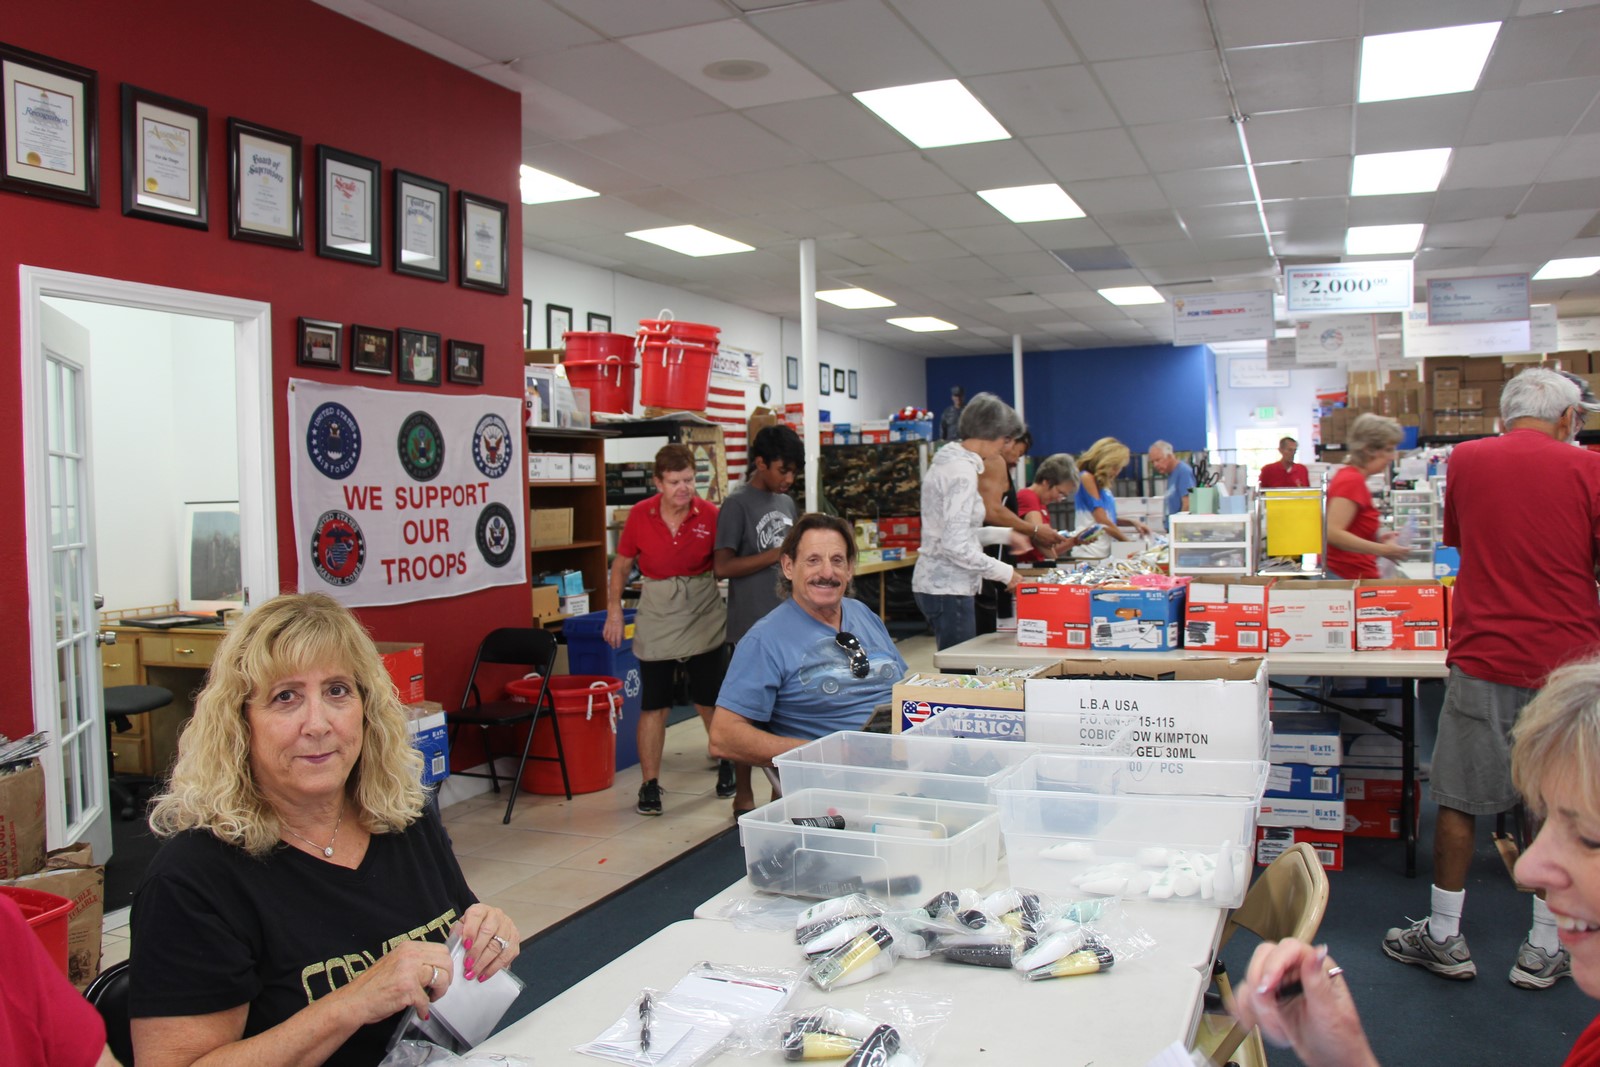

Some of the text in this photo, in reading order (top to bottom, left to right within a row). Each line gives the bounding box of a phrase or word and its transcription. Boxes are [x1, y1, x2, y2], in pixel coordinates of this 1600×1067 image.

[22, 106, 69, 127] Recognition
[252, 154, 281, 171] Board of
[247, 164, 284, 183] Supervisors
[314, 407, 357, 433] UNITED STATES
[316, 455, 354, 473] AIR FORCE
[343, 482, 490, 511] WE SUPPORT
[317, 513, 359, 534] UNITED STATES
[403, 518, 450, 545] OUR
[318, 561, 363, 585] MARINE CORPS
[381, 551, 467, 585] TROOPS
[1080, 698, 1139, 711] L.B.A USA
[928, 717, 1025, 736] AMERICA
[1155, 732, 1209, 745] KIMPTON
[1136, 746, 1161, 758] GEL
[1166, 748, 1196, 759] 30ML
[1160, 762, 1184, 774] PCS
